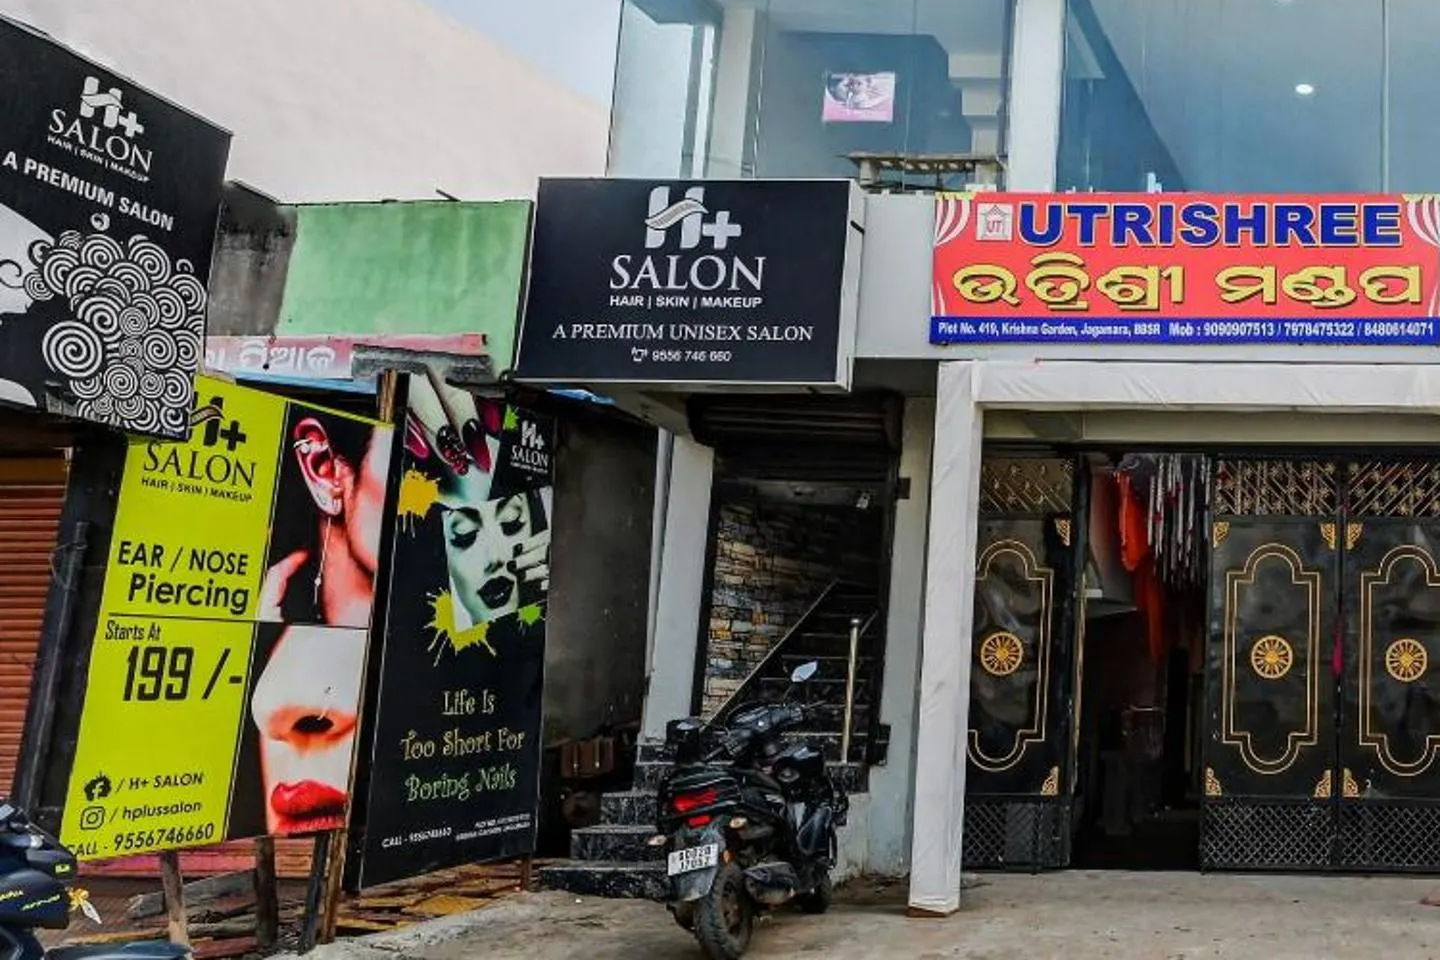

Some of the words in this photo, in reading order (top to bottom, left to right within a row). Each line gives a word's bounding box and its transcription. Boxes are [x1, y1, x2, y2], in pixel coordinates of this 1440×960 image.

[49, 109, 152, 173] SALON
[3, 151, 18, 171] A
[23, 157, 115, 208] PREMIUM
[118, 196, 174, 232] SALON
[1018, 202, 1403, 248] UTRISHREE
[610, 255, 766, 291] SALON
[610, 295, 644, 307] HAIR
[655, 296, 690, 308] SKIN
[701, 296, 762, 309] MAKEUP
[552, 324, 568, 339] A
[571, 324, 664, 340] PREMIUM
[669, 325, 742, 341] UNISEX
[746, 325, 813, 341] SALON
[938, 322, 958, 334] Plot
[960, 322, 976, 335] No.
[1169, 322, 1193, 336] Mob
[143, 442, 257, 488] SALON
[511, 444, 549, 468] SALON
[141, 477, 168, 491] HAIR
[177, 480, 202, 495] SKIN
[210, 488, 252, 503] MAKEUP
[118, 541, 164, 568] EAR
[189, 548, 249, 576] NOSE
[128, 573, 250, 616] Piercing
[105, 620, 145, 640] Starts
[147, 622, 162, 640] At
[123, 646, 194, 701] 199
[442, 689, 476, 716] Life
[482, 689, 497, 715] Is
[401, 729, 435, 761] Too
[443, 727, 492, 757] Short
[498, 727, 526, 752] For
[153, 772, 205, 789] SALON
[405, 773, 471, 802] Boring
[476, 763, 517, 792] Nails
[122, 800, 202, 822] hplussalon
[113, 823, 214, 851] 9556746660
